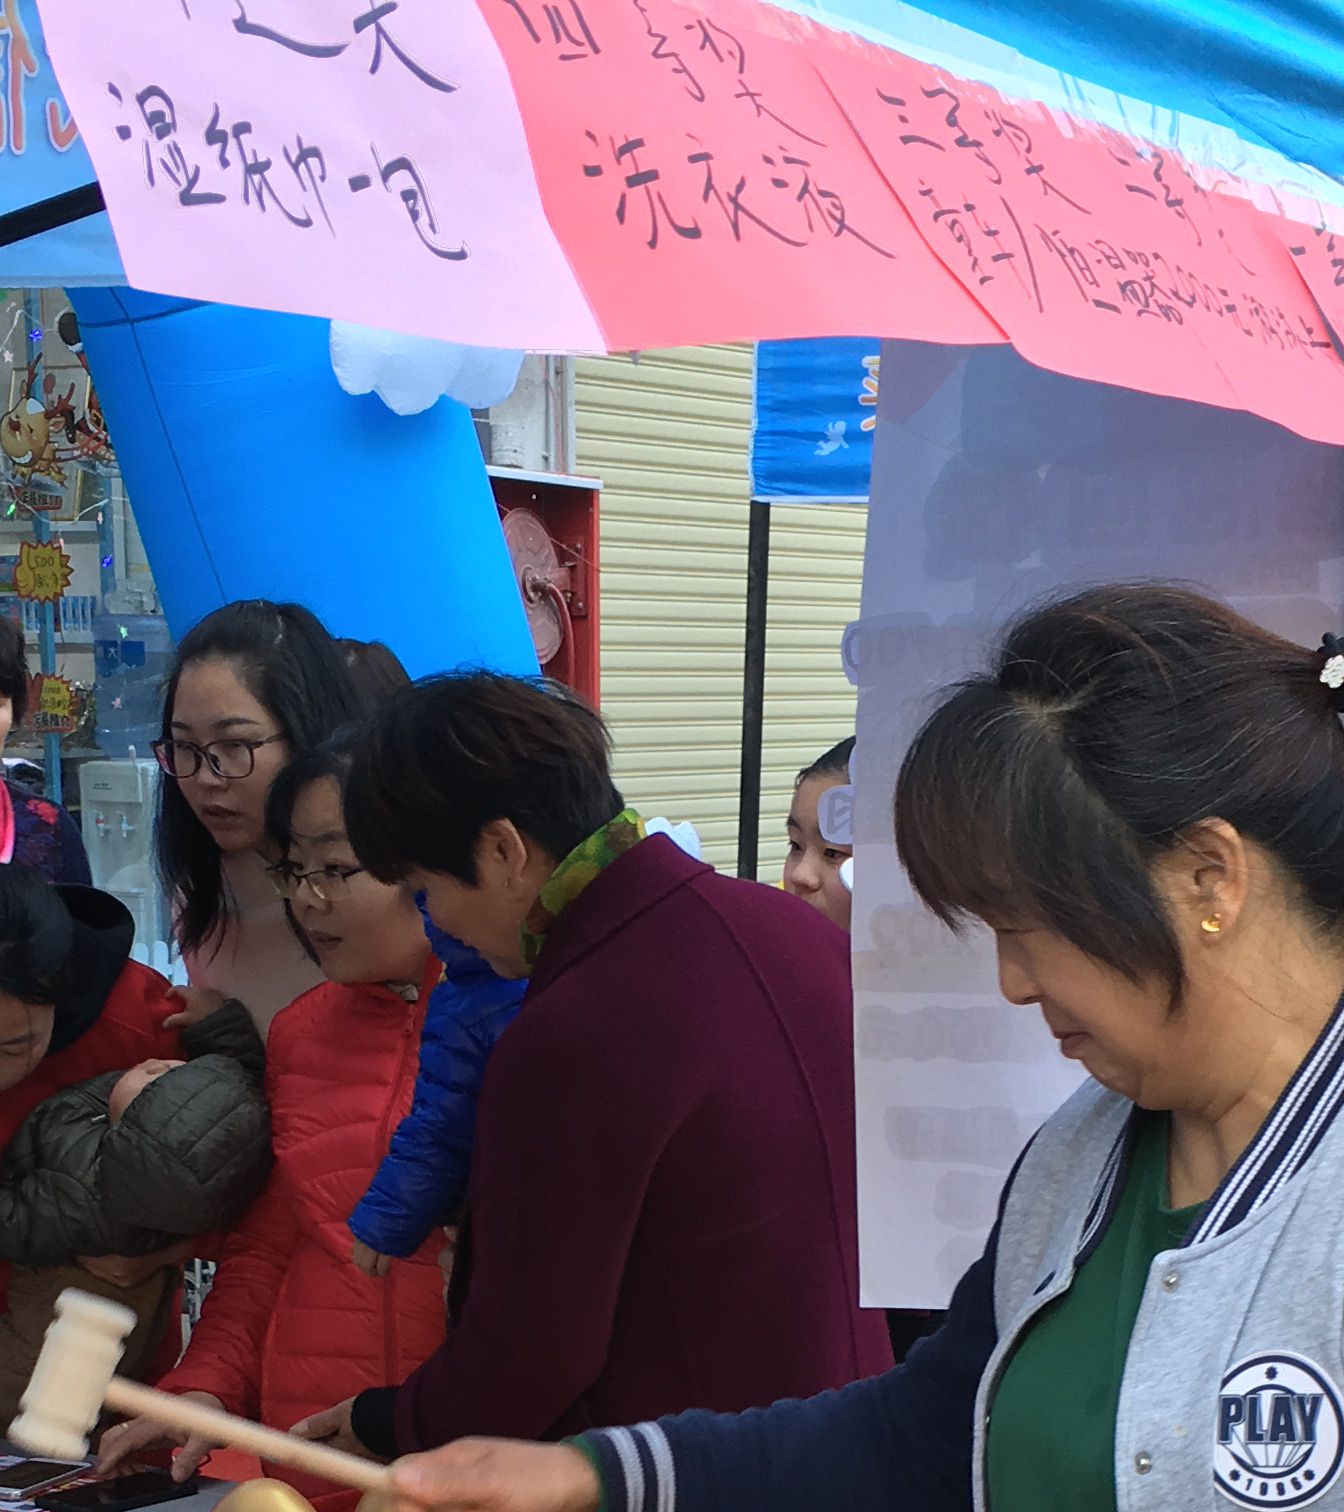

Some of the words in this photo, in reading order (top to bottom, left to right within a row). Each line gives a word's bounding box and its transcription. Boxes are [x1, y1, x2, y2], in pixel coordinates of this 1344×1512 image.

[581, 128, 897, 259] 洗衣液
[1217, 1393, 1325, 1445] PLAY
